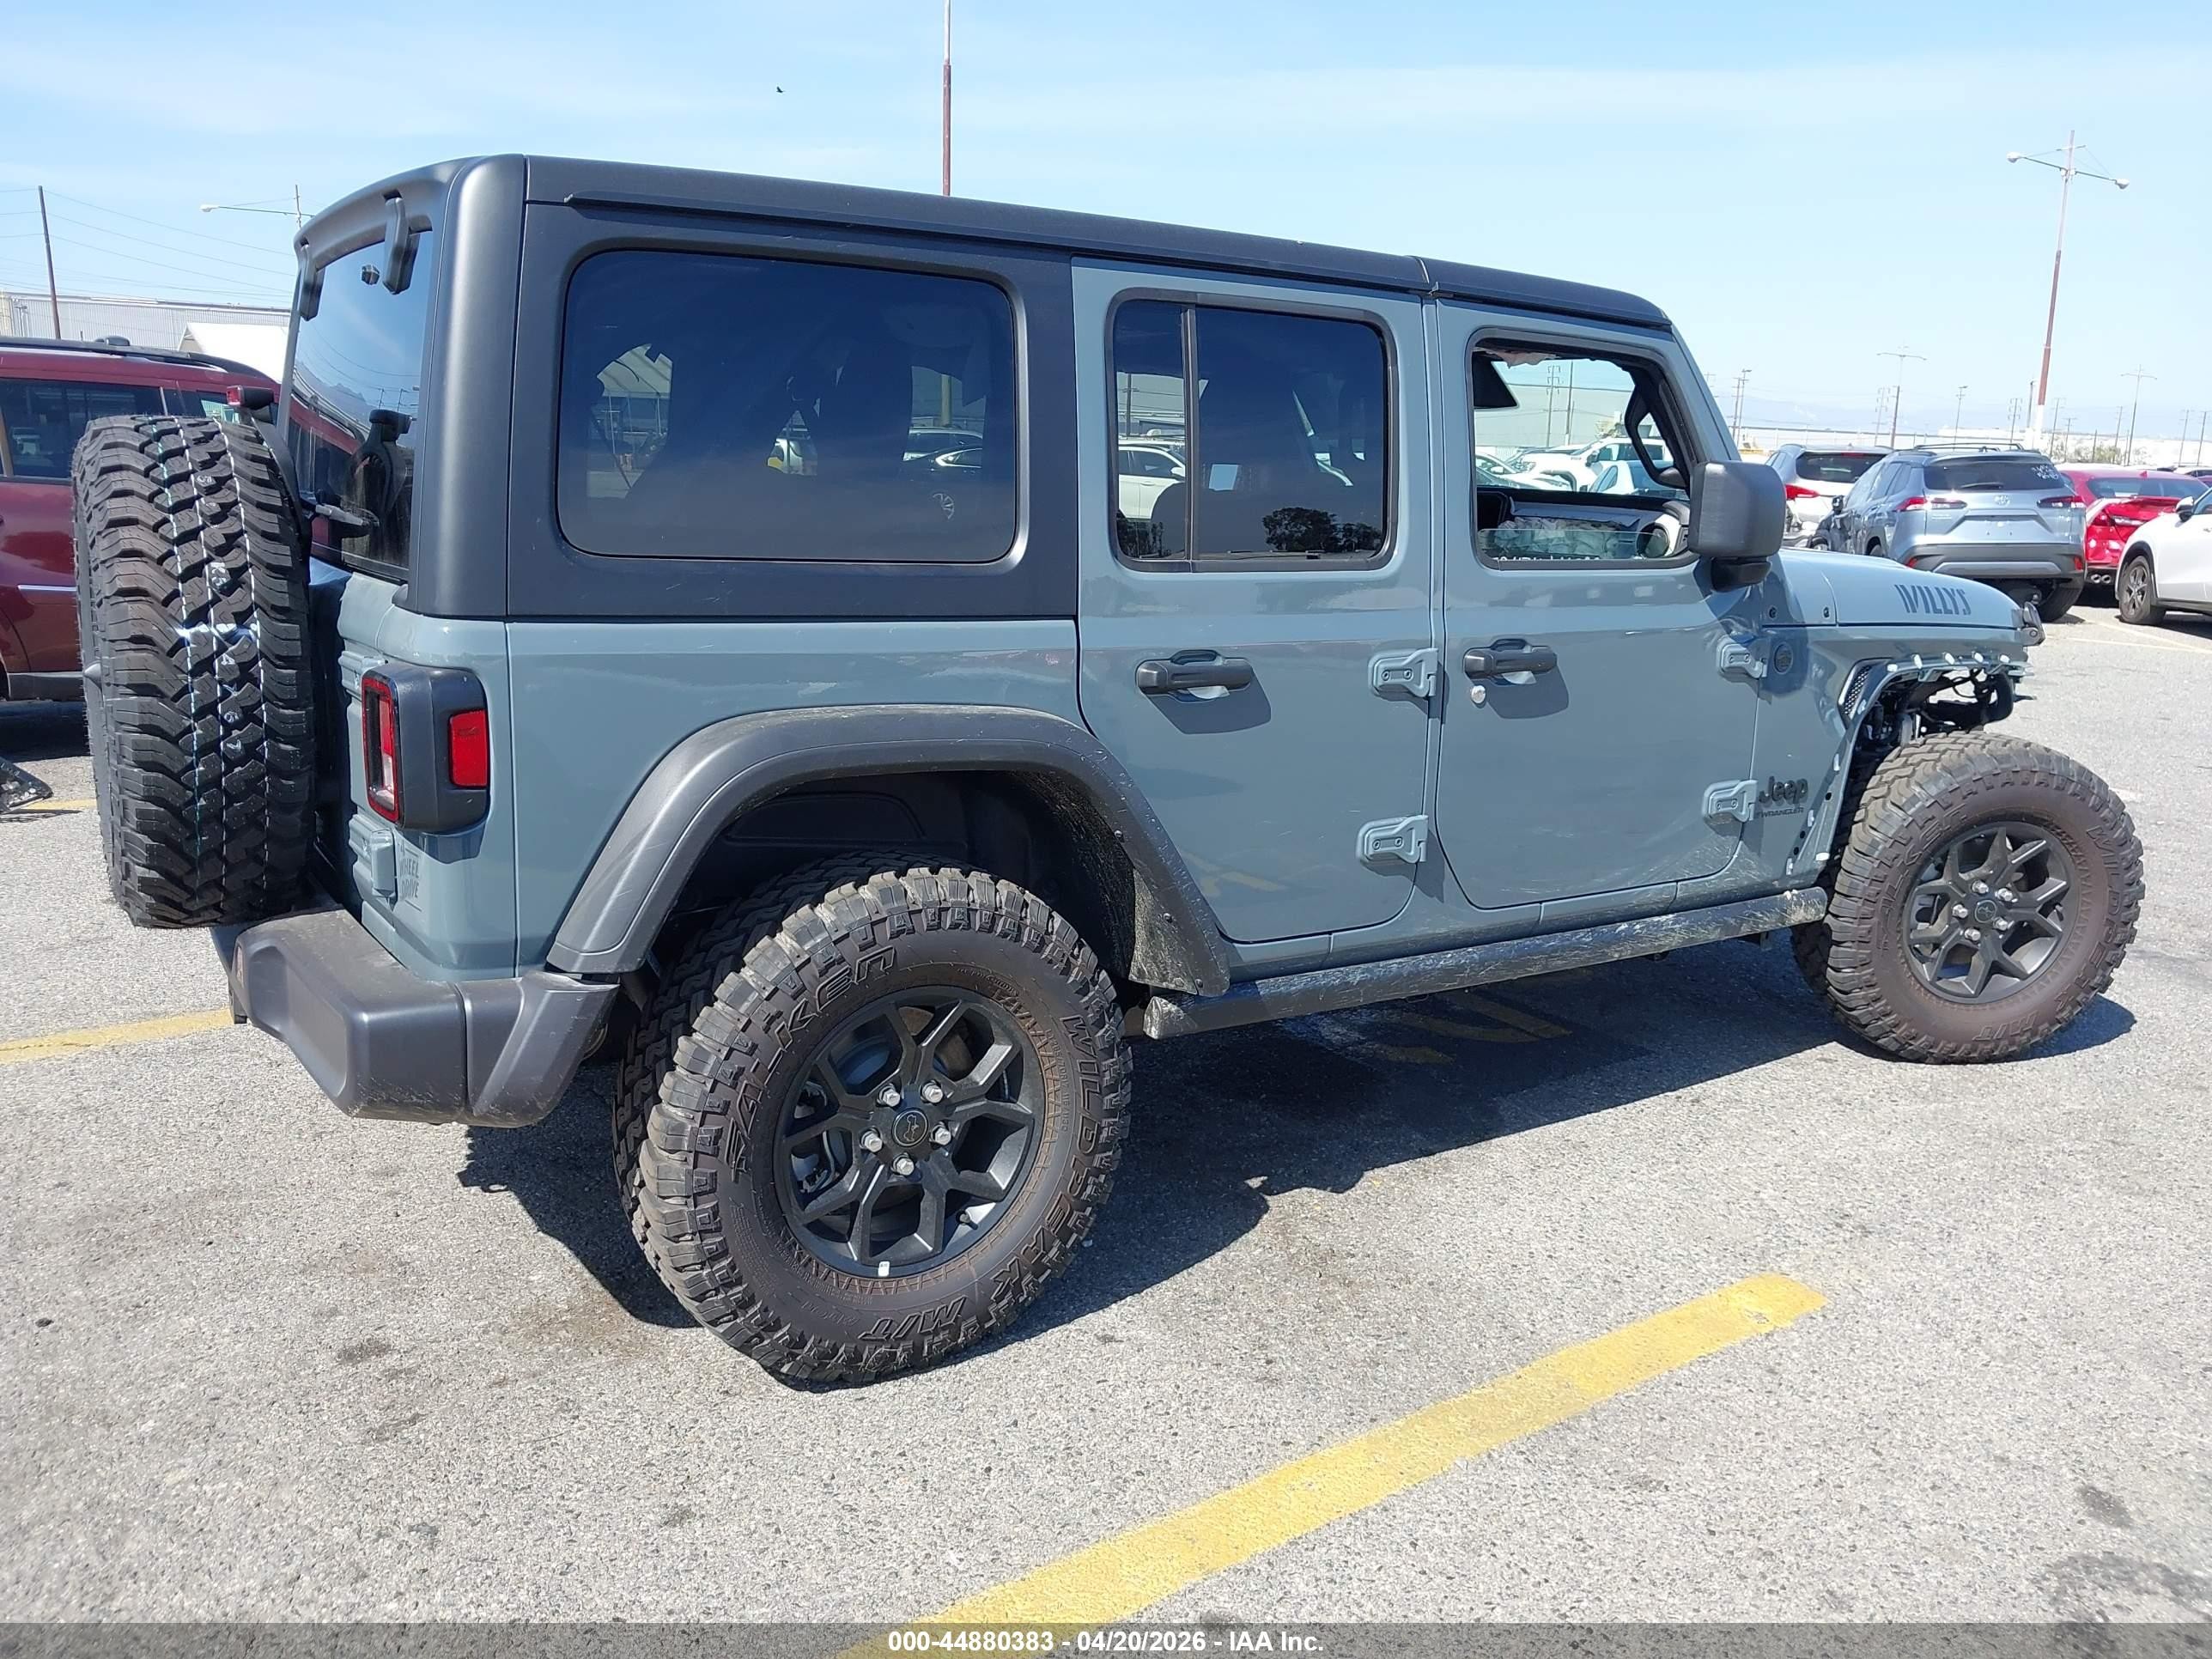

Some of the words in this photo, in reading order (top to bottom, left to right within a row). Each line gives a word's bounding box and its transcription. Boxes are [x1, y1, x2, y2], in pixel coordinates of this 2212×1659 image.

[1893, 584, 1972, 616] WILLYS
[1758, 775, 1808, 805] Jeep
[1760, 807, 1805, 818] WRANGLER
[989, 1014, 1103, 1303] WILDPEAK
[857, 1296, 969, 1341] M/T
